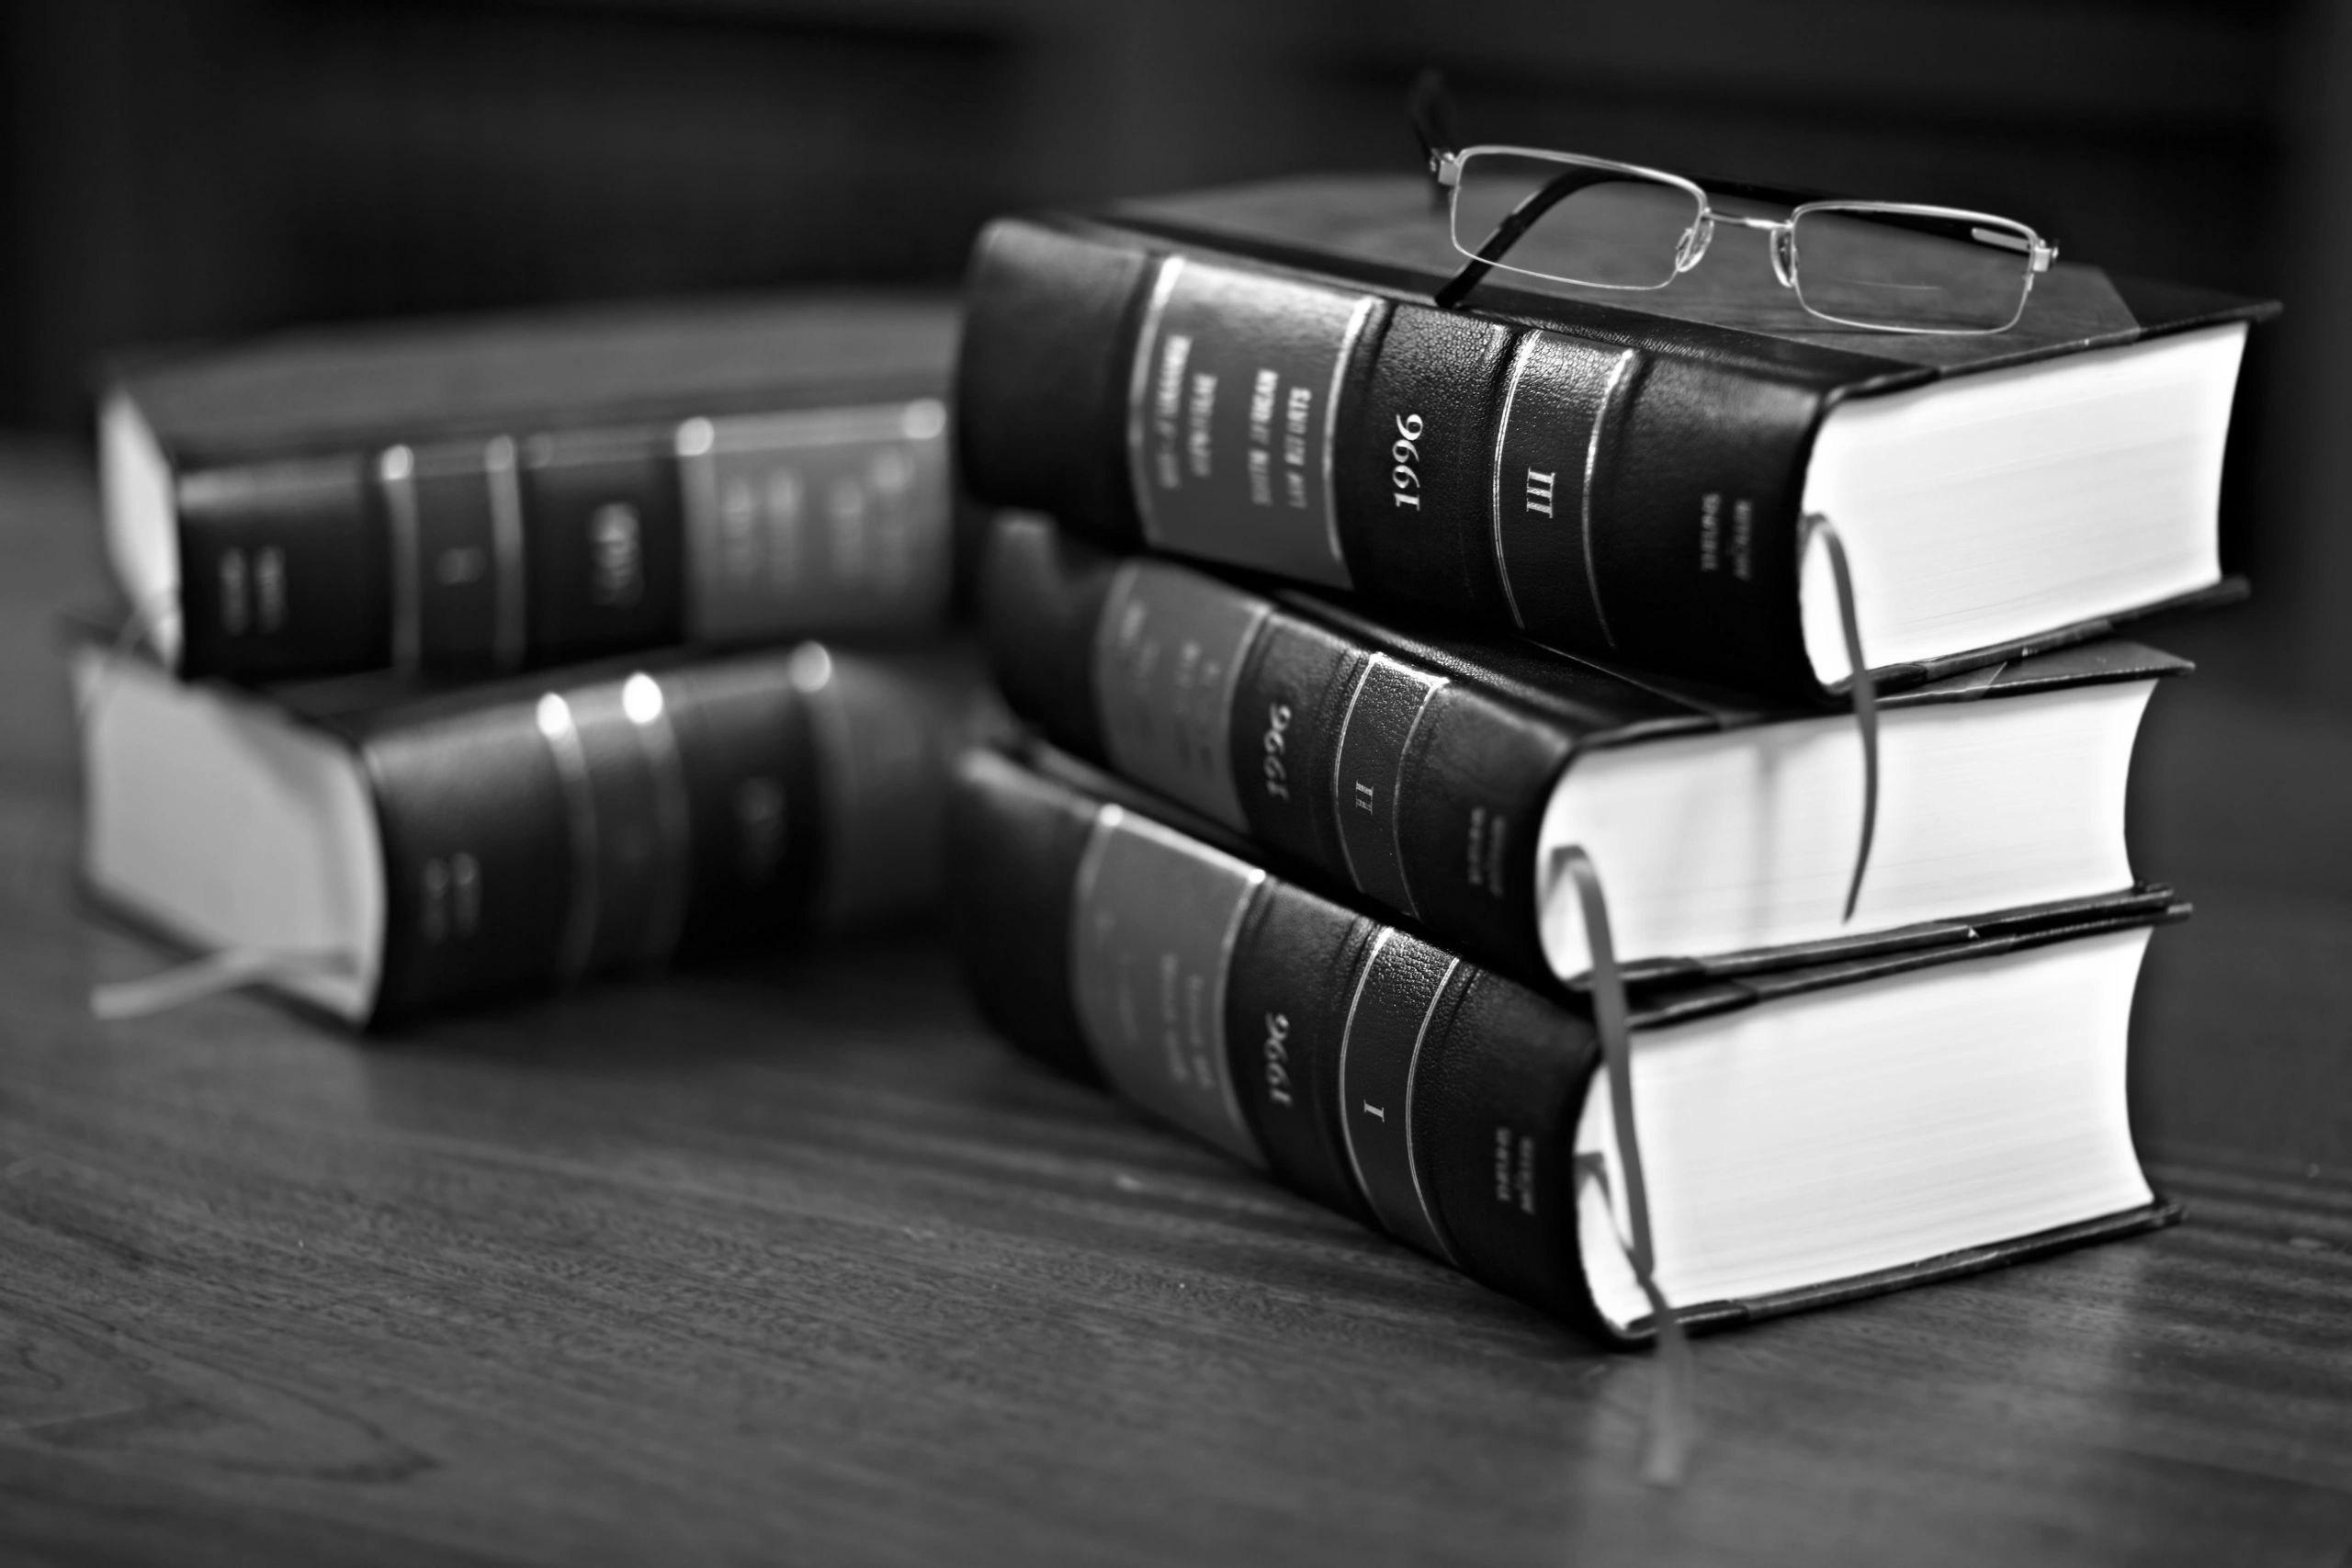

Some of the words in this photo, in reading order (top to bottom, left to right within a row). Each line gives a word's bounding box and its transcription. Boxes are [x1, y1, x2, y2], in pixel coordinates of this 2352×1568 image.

[1392, 413, 1423, 512] 1996
[1526, 467, 1555, 519] III
[1263, 704, 1292, 800] 1996
[1355, 781, 1374, 815] II
[1263, 1011, 1292, 1108] 1996
[1363, 1100, 1385, 1122] I
